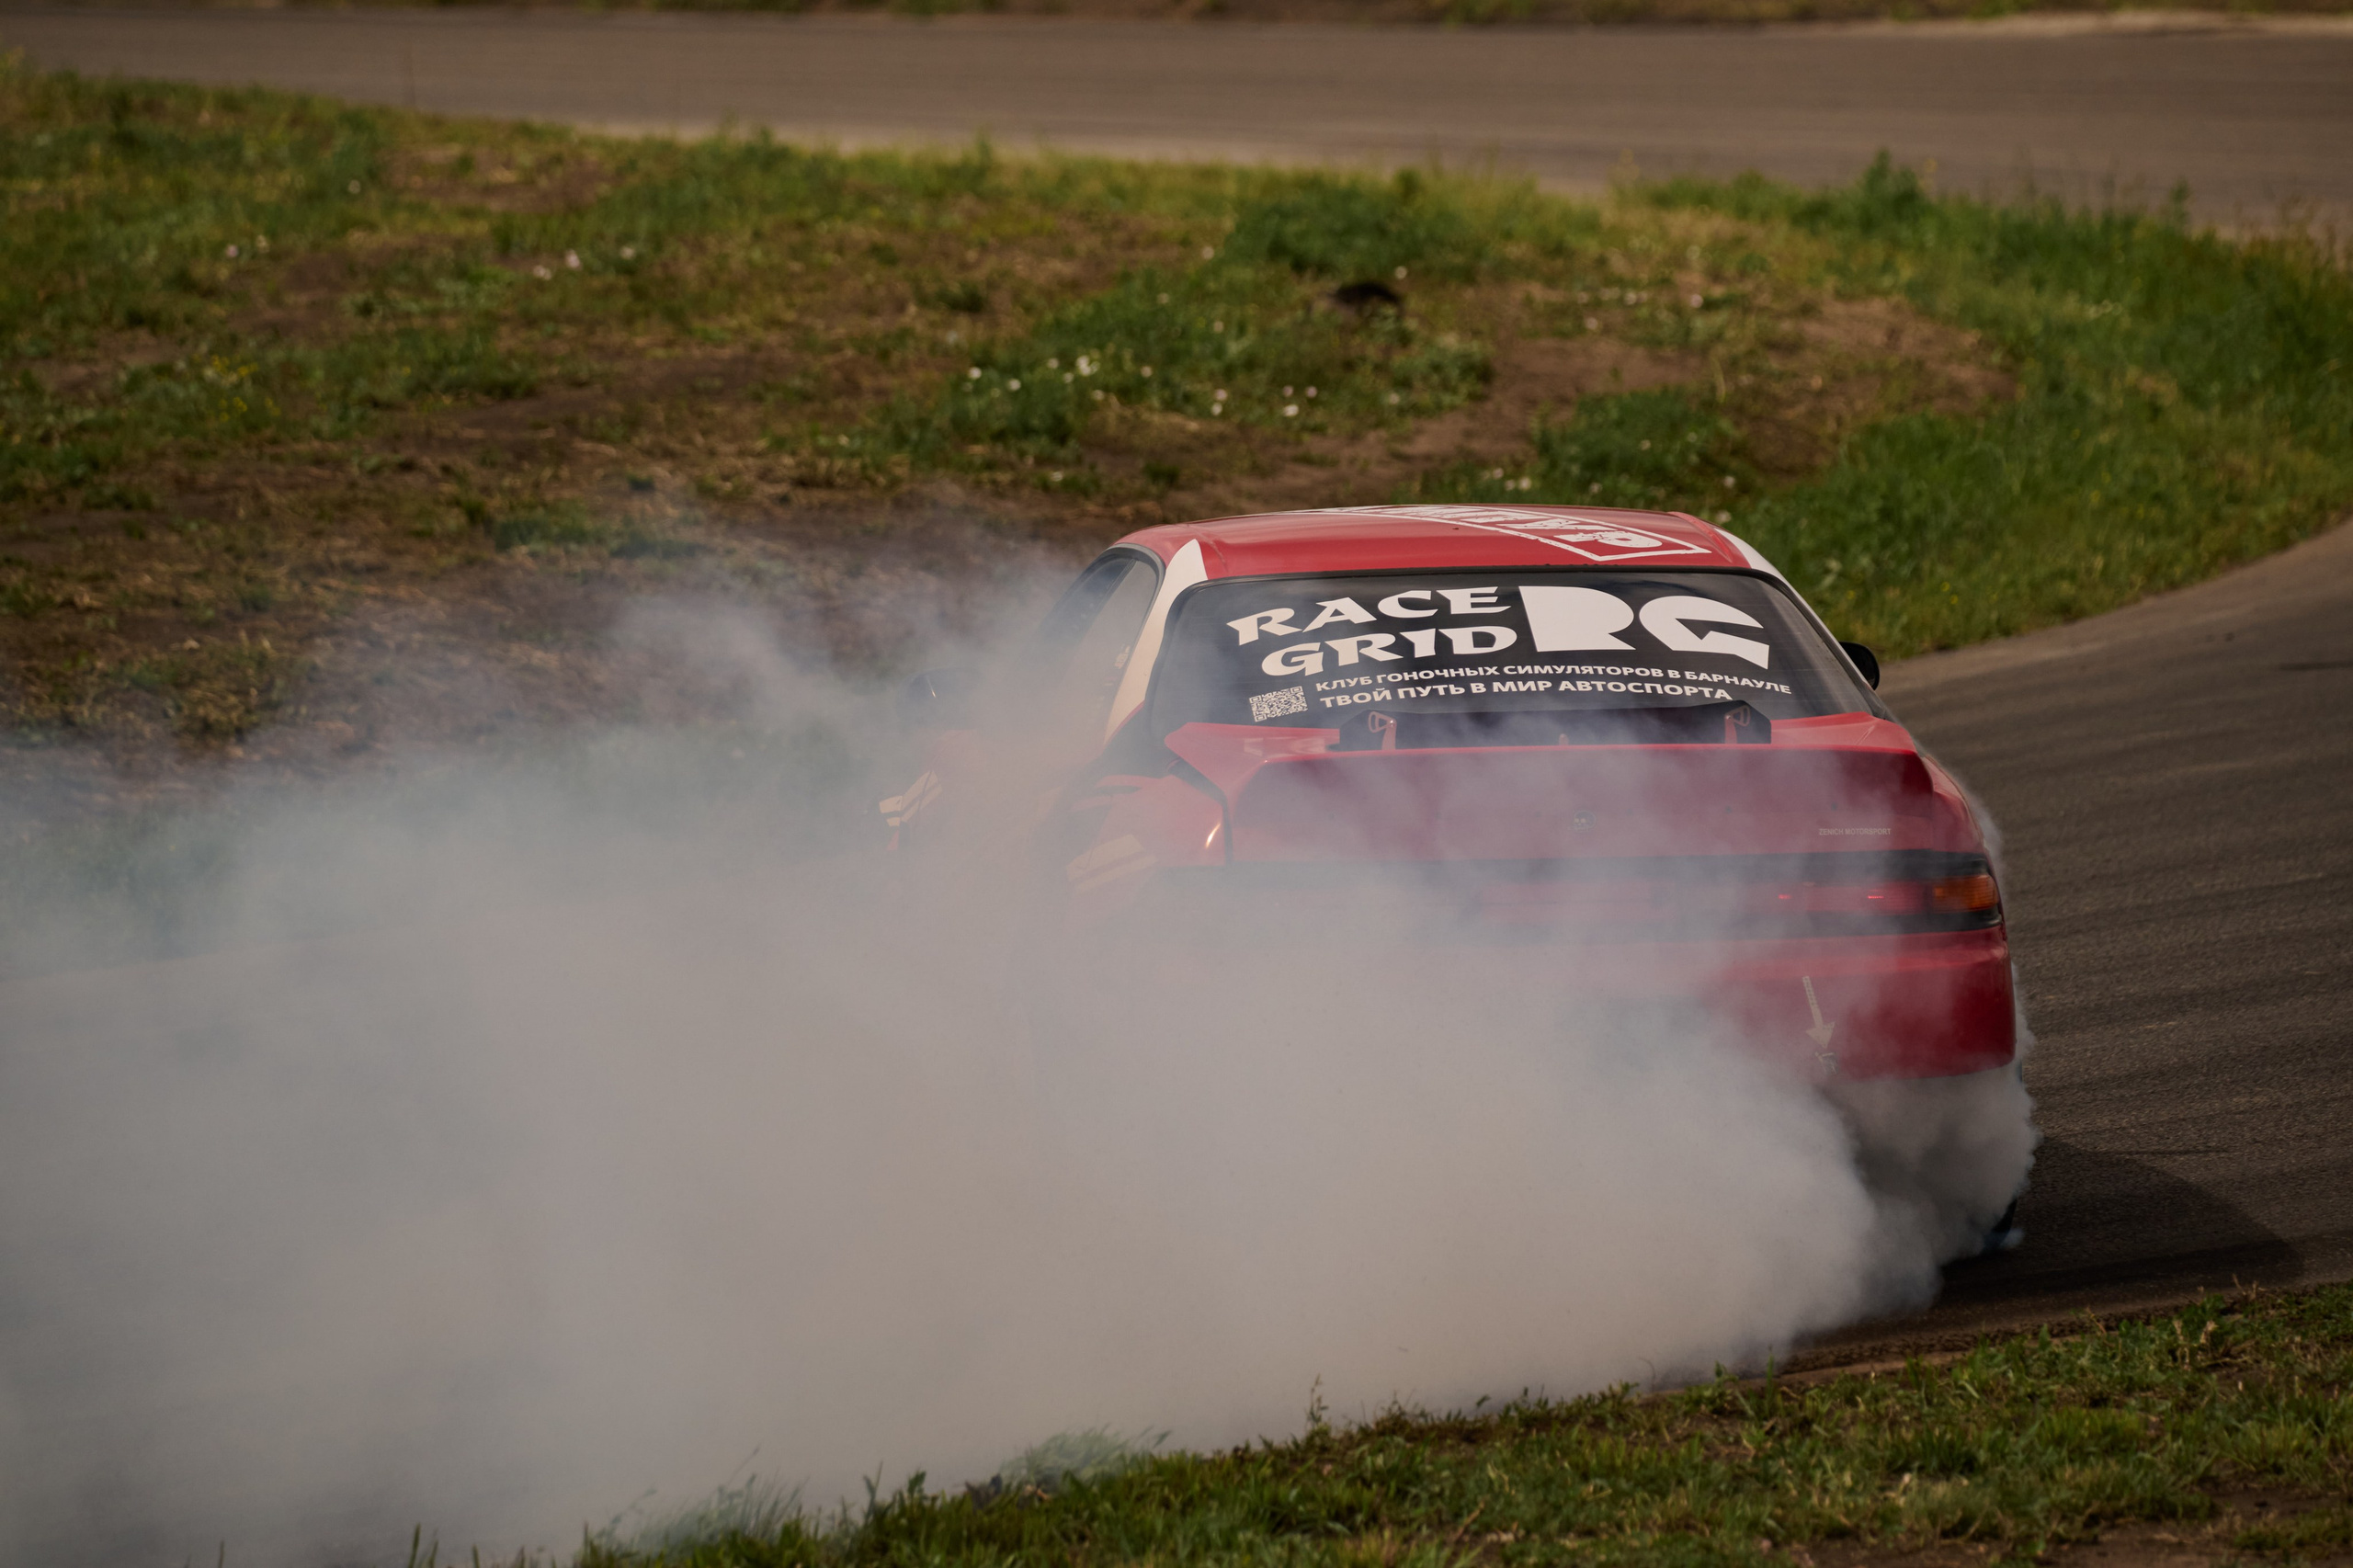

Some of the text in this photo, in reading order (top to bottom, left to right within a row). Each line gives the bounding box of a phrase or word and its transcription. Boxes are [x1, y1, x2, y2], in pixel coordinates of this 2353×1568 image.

[1226, 586, 1512, 645] RACE
[1518, 585, 1770, 670] RG
[1261, 626, 1518, 676] GRID
[1315, 665, 1792, 695] КЛУБ ГОНОЧНЫХ СИМУЛЯТОРОВ В БАРНАУЛЕ
[1319, 680, 1733, 709] ТВОЙ ПУТЬ В МИР АВТОСПОРТА
